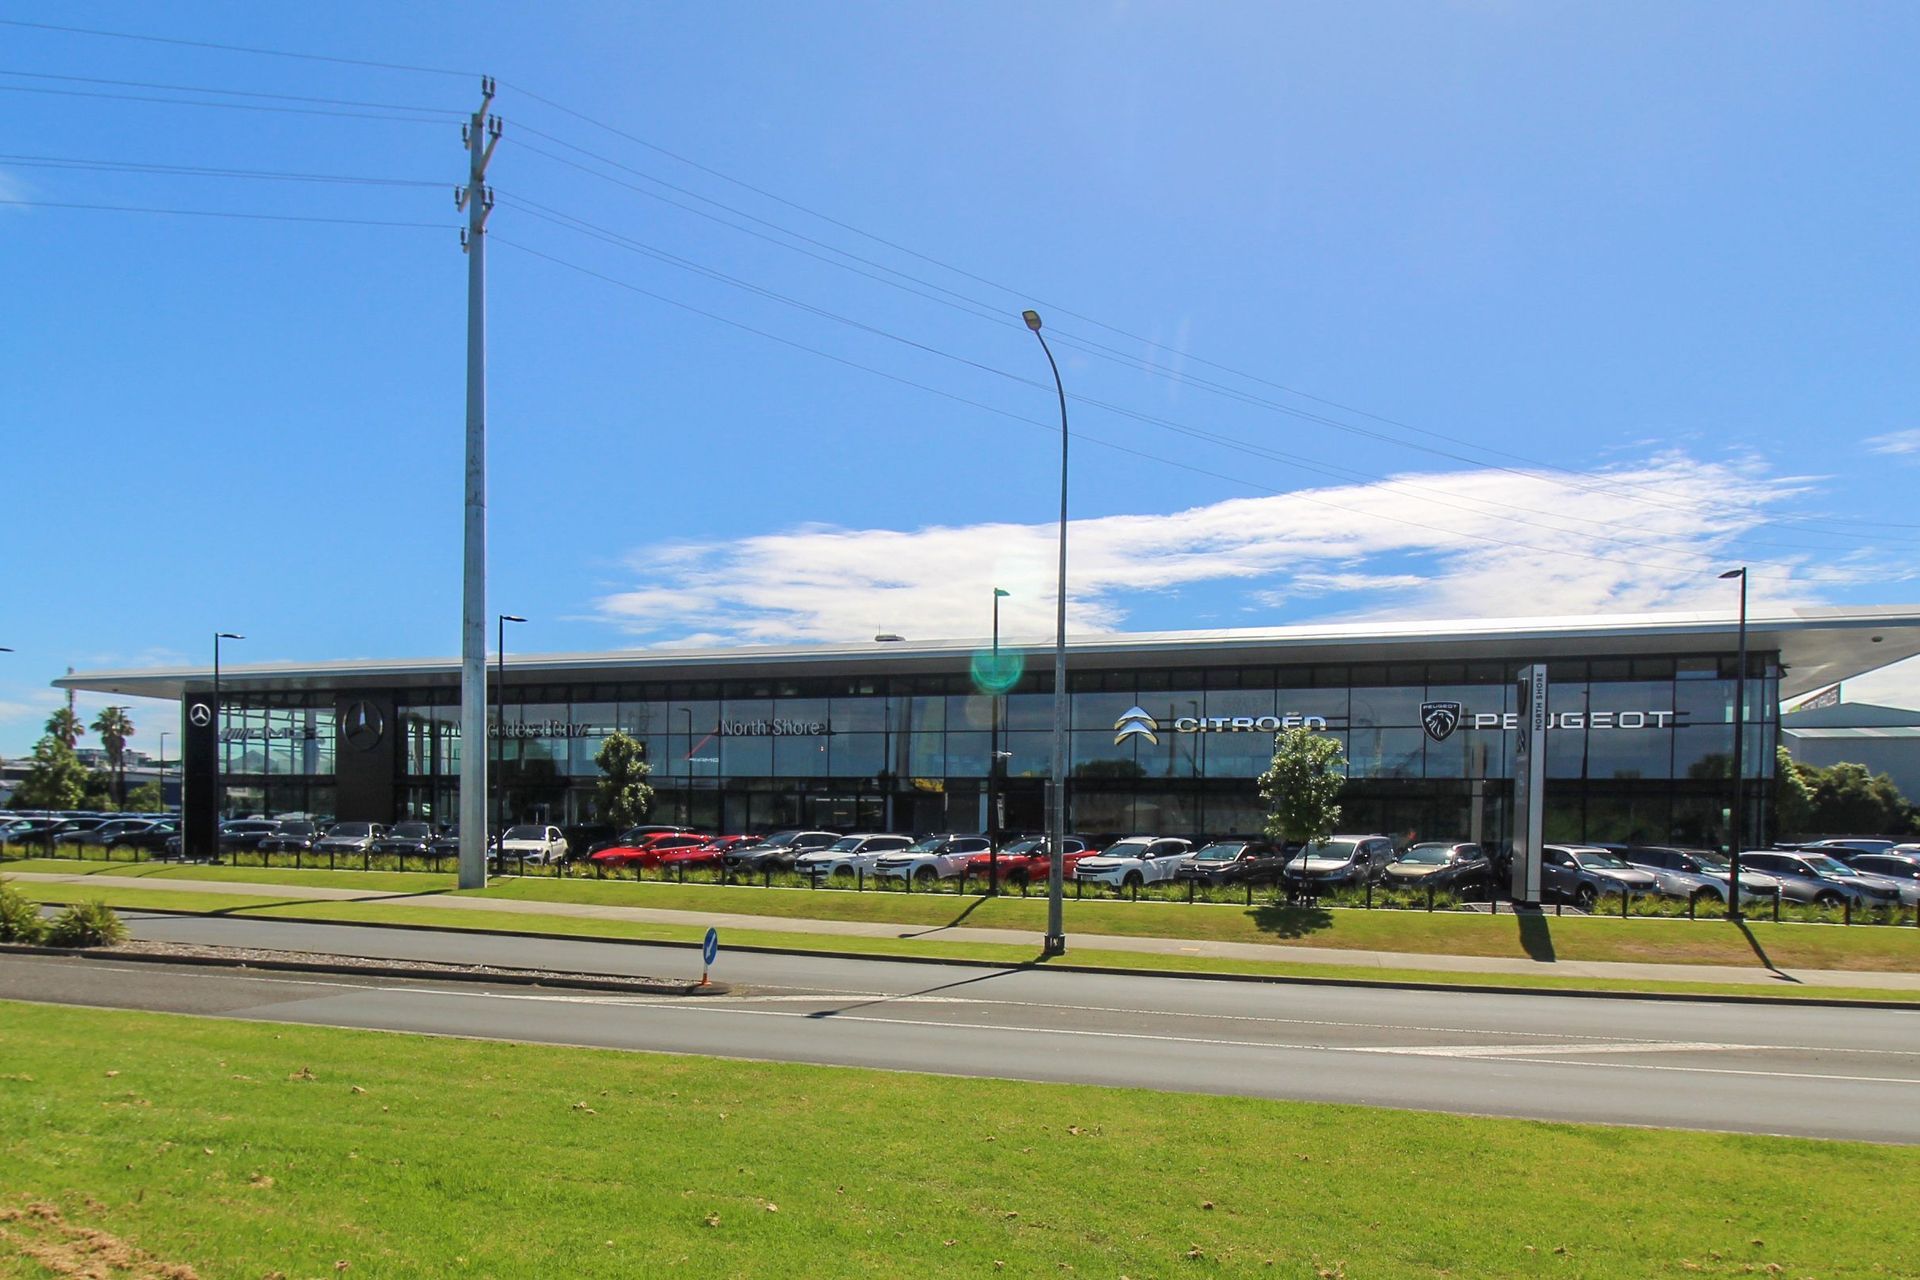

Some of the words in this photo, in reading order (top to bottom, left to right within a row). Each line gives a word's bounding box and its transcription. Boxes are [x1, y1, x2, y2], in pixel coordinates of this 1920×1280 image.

[1536, 672, 1544, 701] SHORE
[721, 719, 766, 735] North
[772, 718, 820, 735] Shore
[1475, 711, 1674, 730] PEGEOT
[1535, 702, 1543, 731] NORTH
